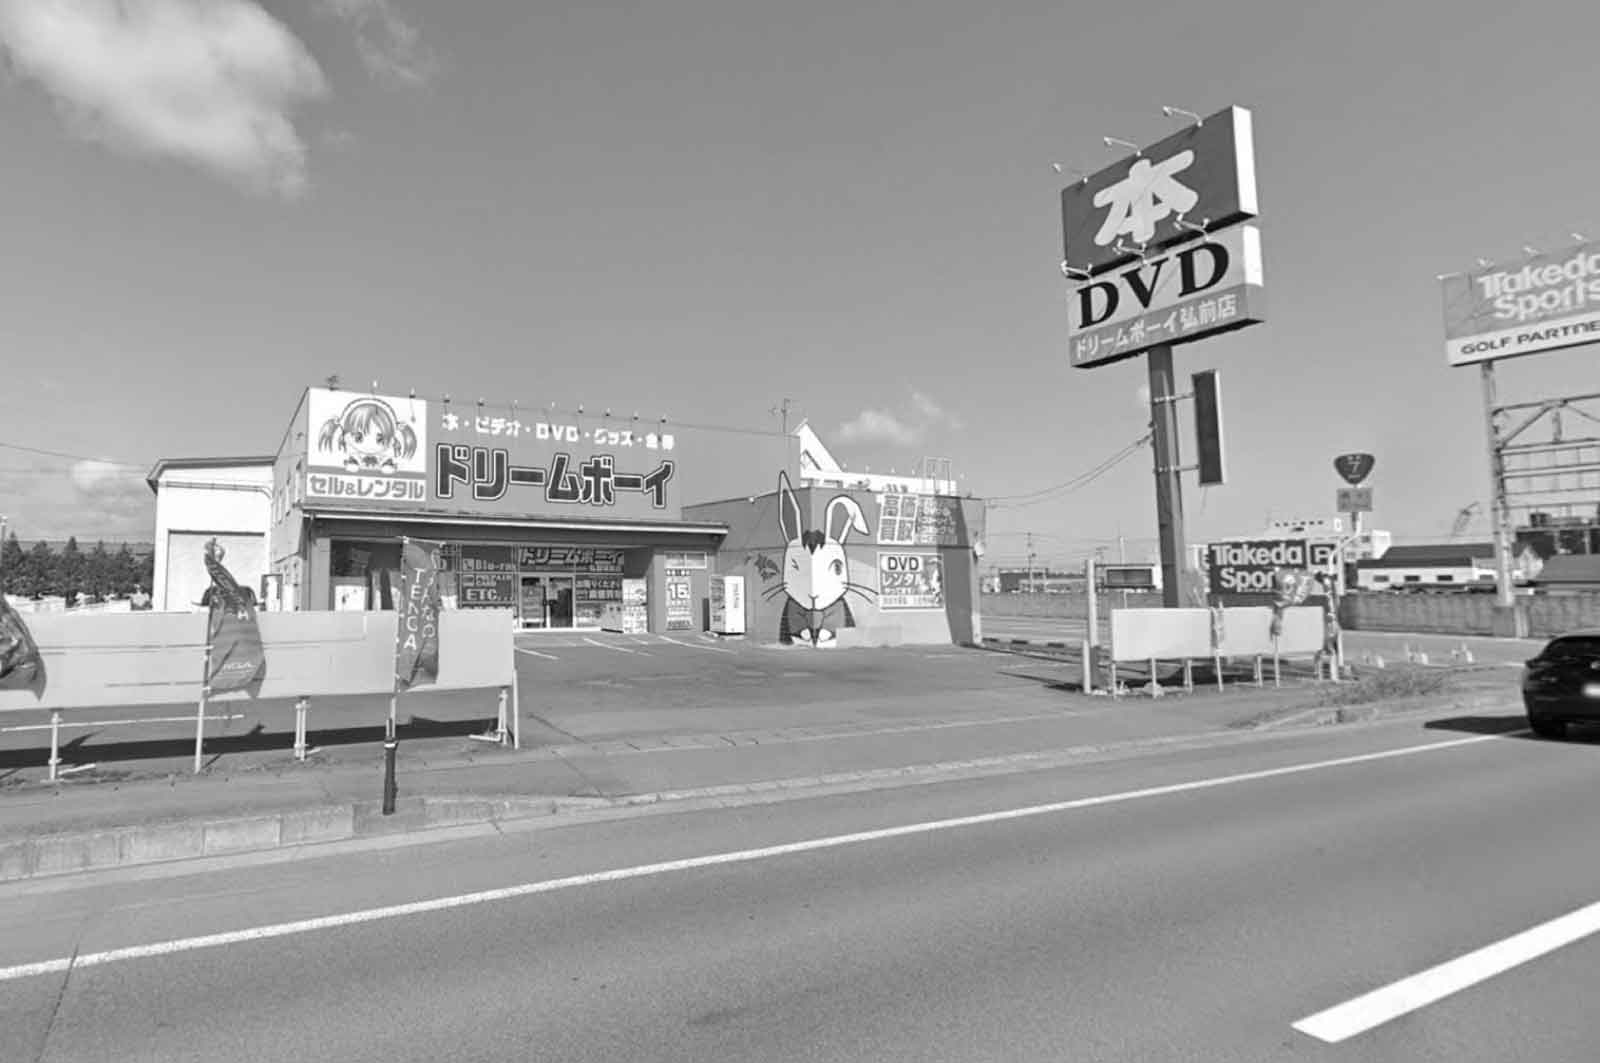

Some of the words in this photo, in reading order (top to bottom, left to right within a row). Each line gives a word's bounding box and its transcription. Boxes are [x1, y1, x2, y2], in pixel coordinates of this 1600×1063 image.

[1093, 149, 1199, 246] 本
[1076, 242, 1229, 329] DVD
[1075, 294, 1237, 359] ドリームボーイ弘前店
[1461, 337, 1512, 354] GOLF
[436, 442, 674, 508] ドリームボーイ
[888, 556, 919, 570] DVD
[1211, 543, 1303, 566] Takeda
[1220, 567, 1275, 593] Spor
